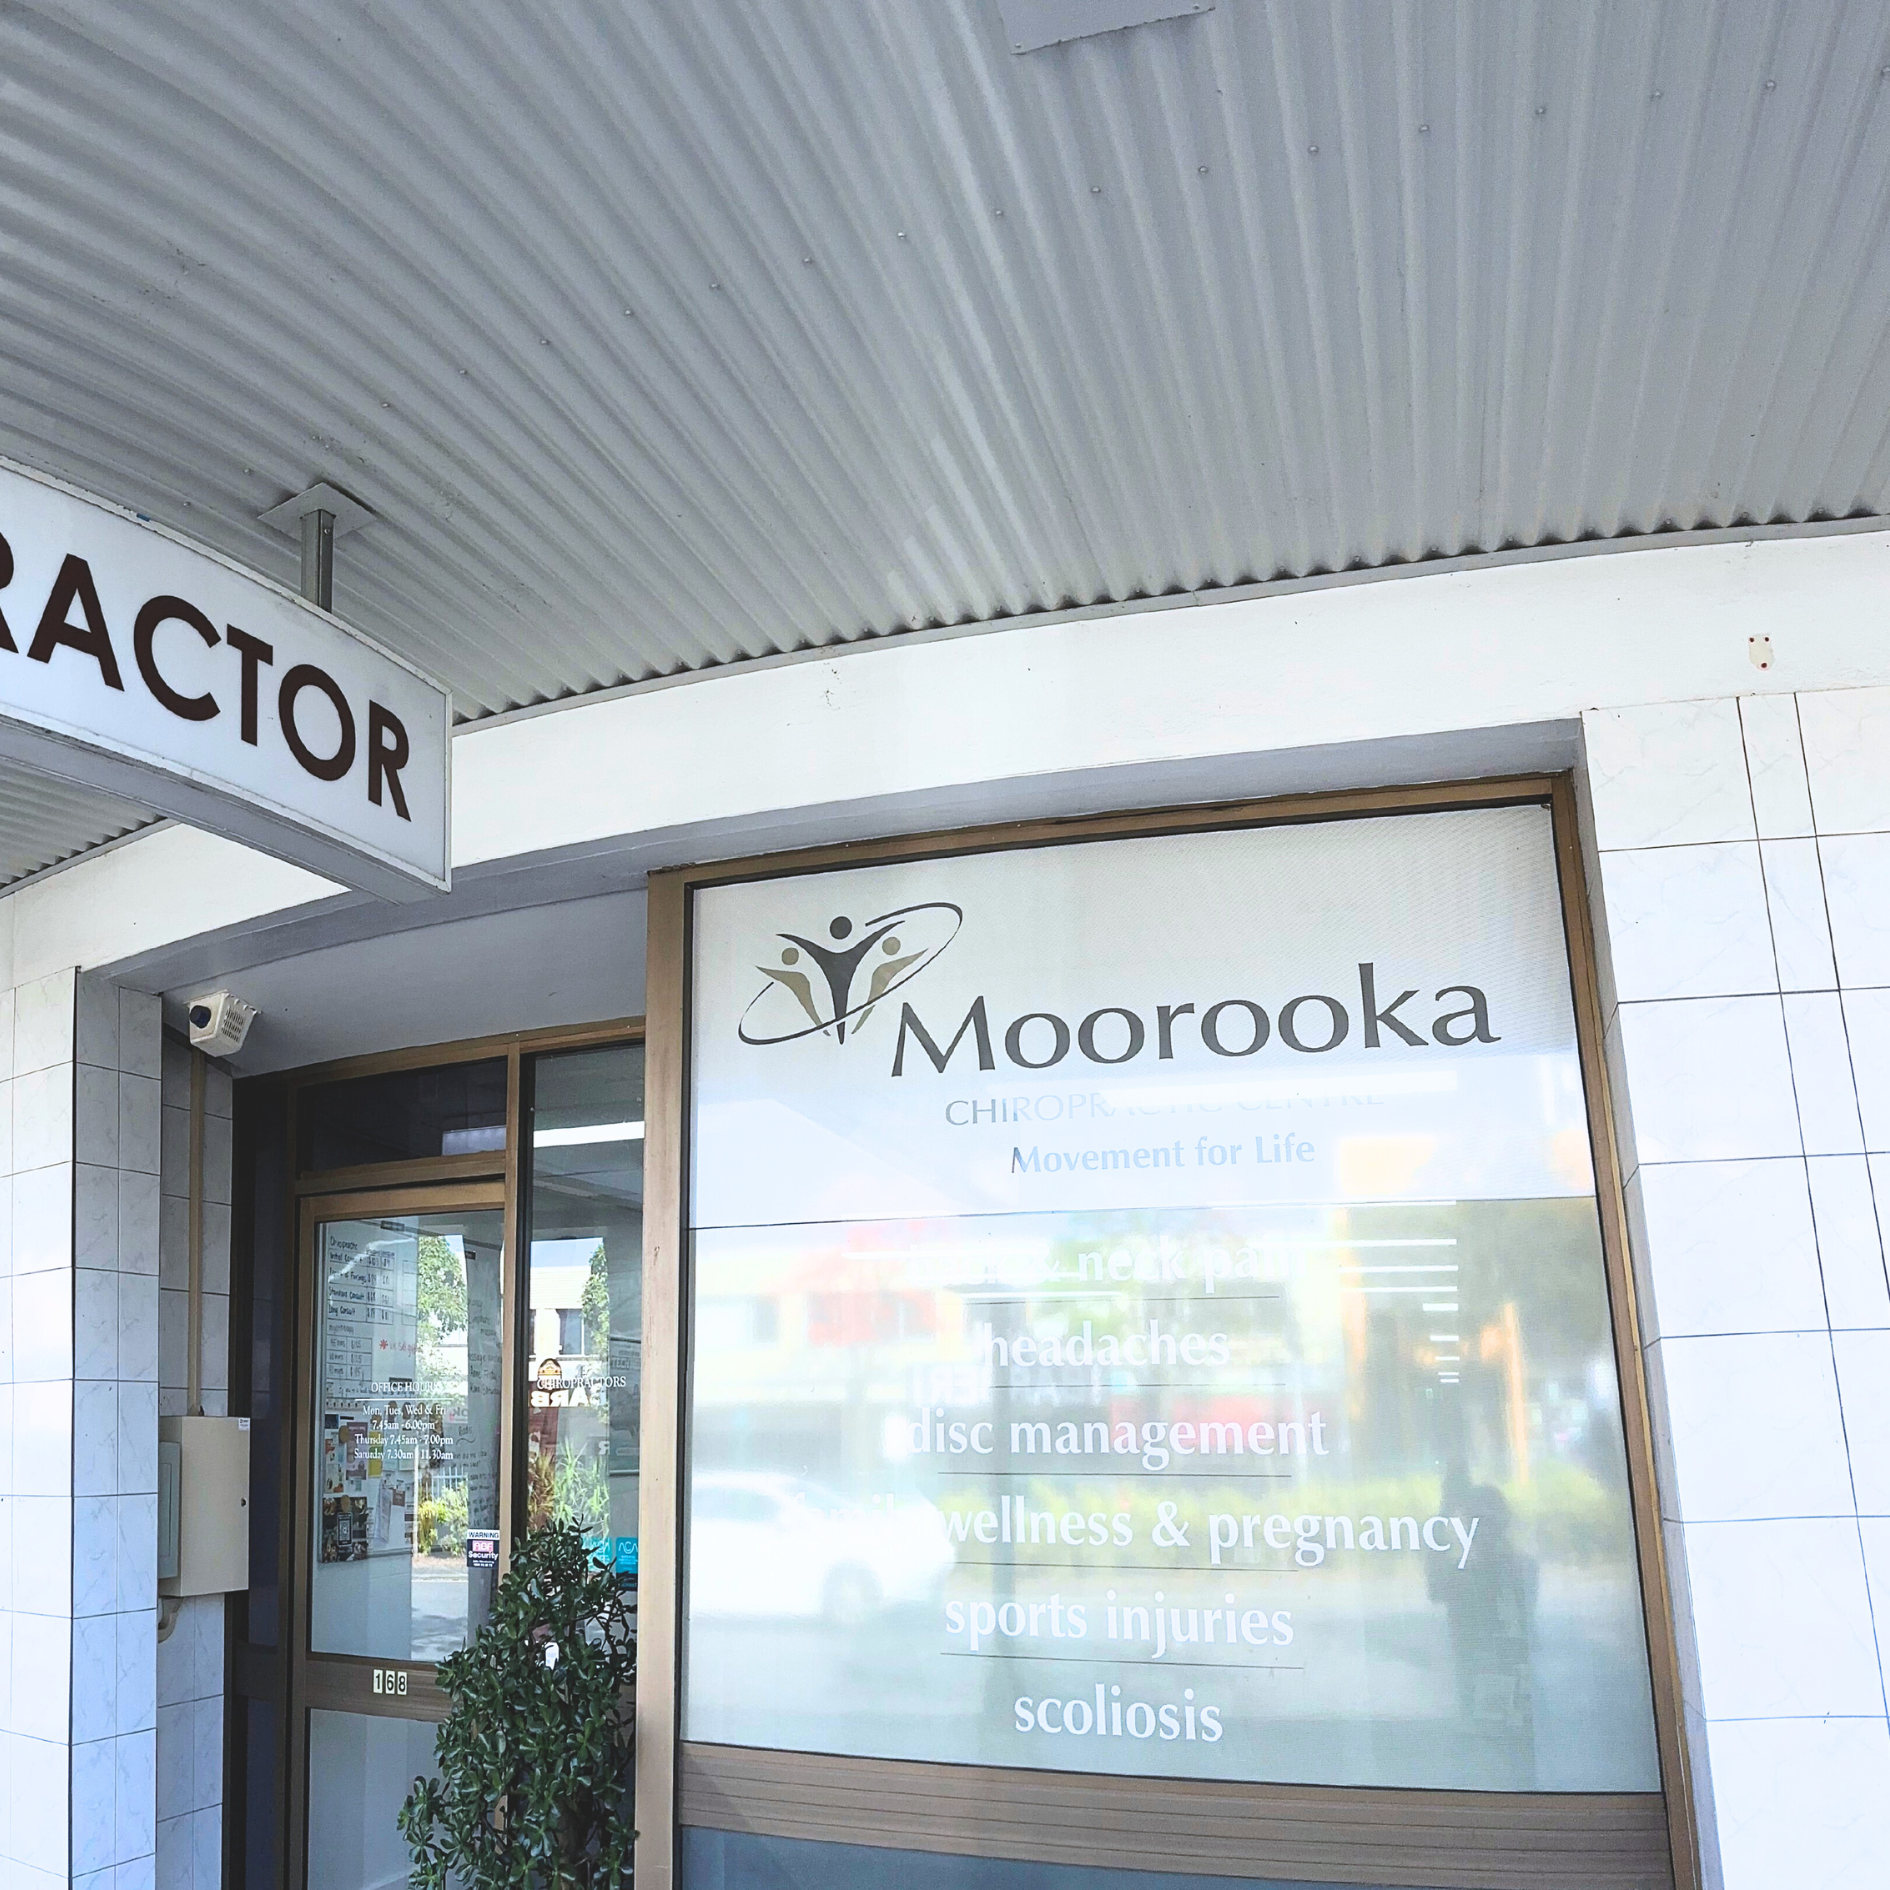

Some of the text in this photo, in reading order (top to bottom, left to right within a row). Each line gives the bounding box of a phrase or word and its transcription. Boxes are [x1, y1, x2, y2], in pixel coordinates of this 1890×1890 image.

[892, 963, 1501, 1077] Moorooka
[1012, 1132, 1315, 1173] Movement for Life
[1029, 1244, 1061, 1282] &
[1079, 1235, 1186, 1282] neck
[982, 1320, 1230, 1367] headaches
[371, 1381, 404, 1393] OFFICE
[537, 1376, 626, 1389] CHIROPRACTORS
[405, 1405, 422, 1415] Wed
[424, 1405, 433, 1415] &
[436, 1404, 446, 1415] Fri
[372, 1420, 399, 1430] 7.45am
[405, 1420, 435, 1432] 6.00pm
[354, 1433, 389, 1446] Thursday
[390, 1434, 418, 1445] 7.45am
[424, 1433, 454, 1446] 7.00pm
[910, 1407, 1329, 1471] disc management
[354, 1449, 385, 1461] Saturday
[387, 1449, 414, 1460] 7.30am
[420, 1448, 454, 1460] 11.30am
[469, 1531, 499, 1539] WARNING
[938, 1495, 1133, 1547] wellness
[1151, 1501, 1191, 1547] &
[1211, 1510, 1479, 1569] pregnancy
[468, 1551, 498, 1561] Security
[946, 1589, 1294, 1658] sports injuries
[375, 1673, 406, 1692] 168
[1015, 1684, 1223, 1742] scoliosis
